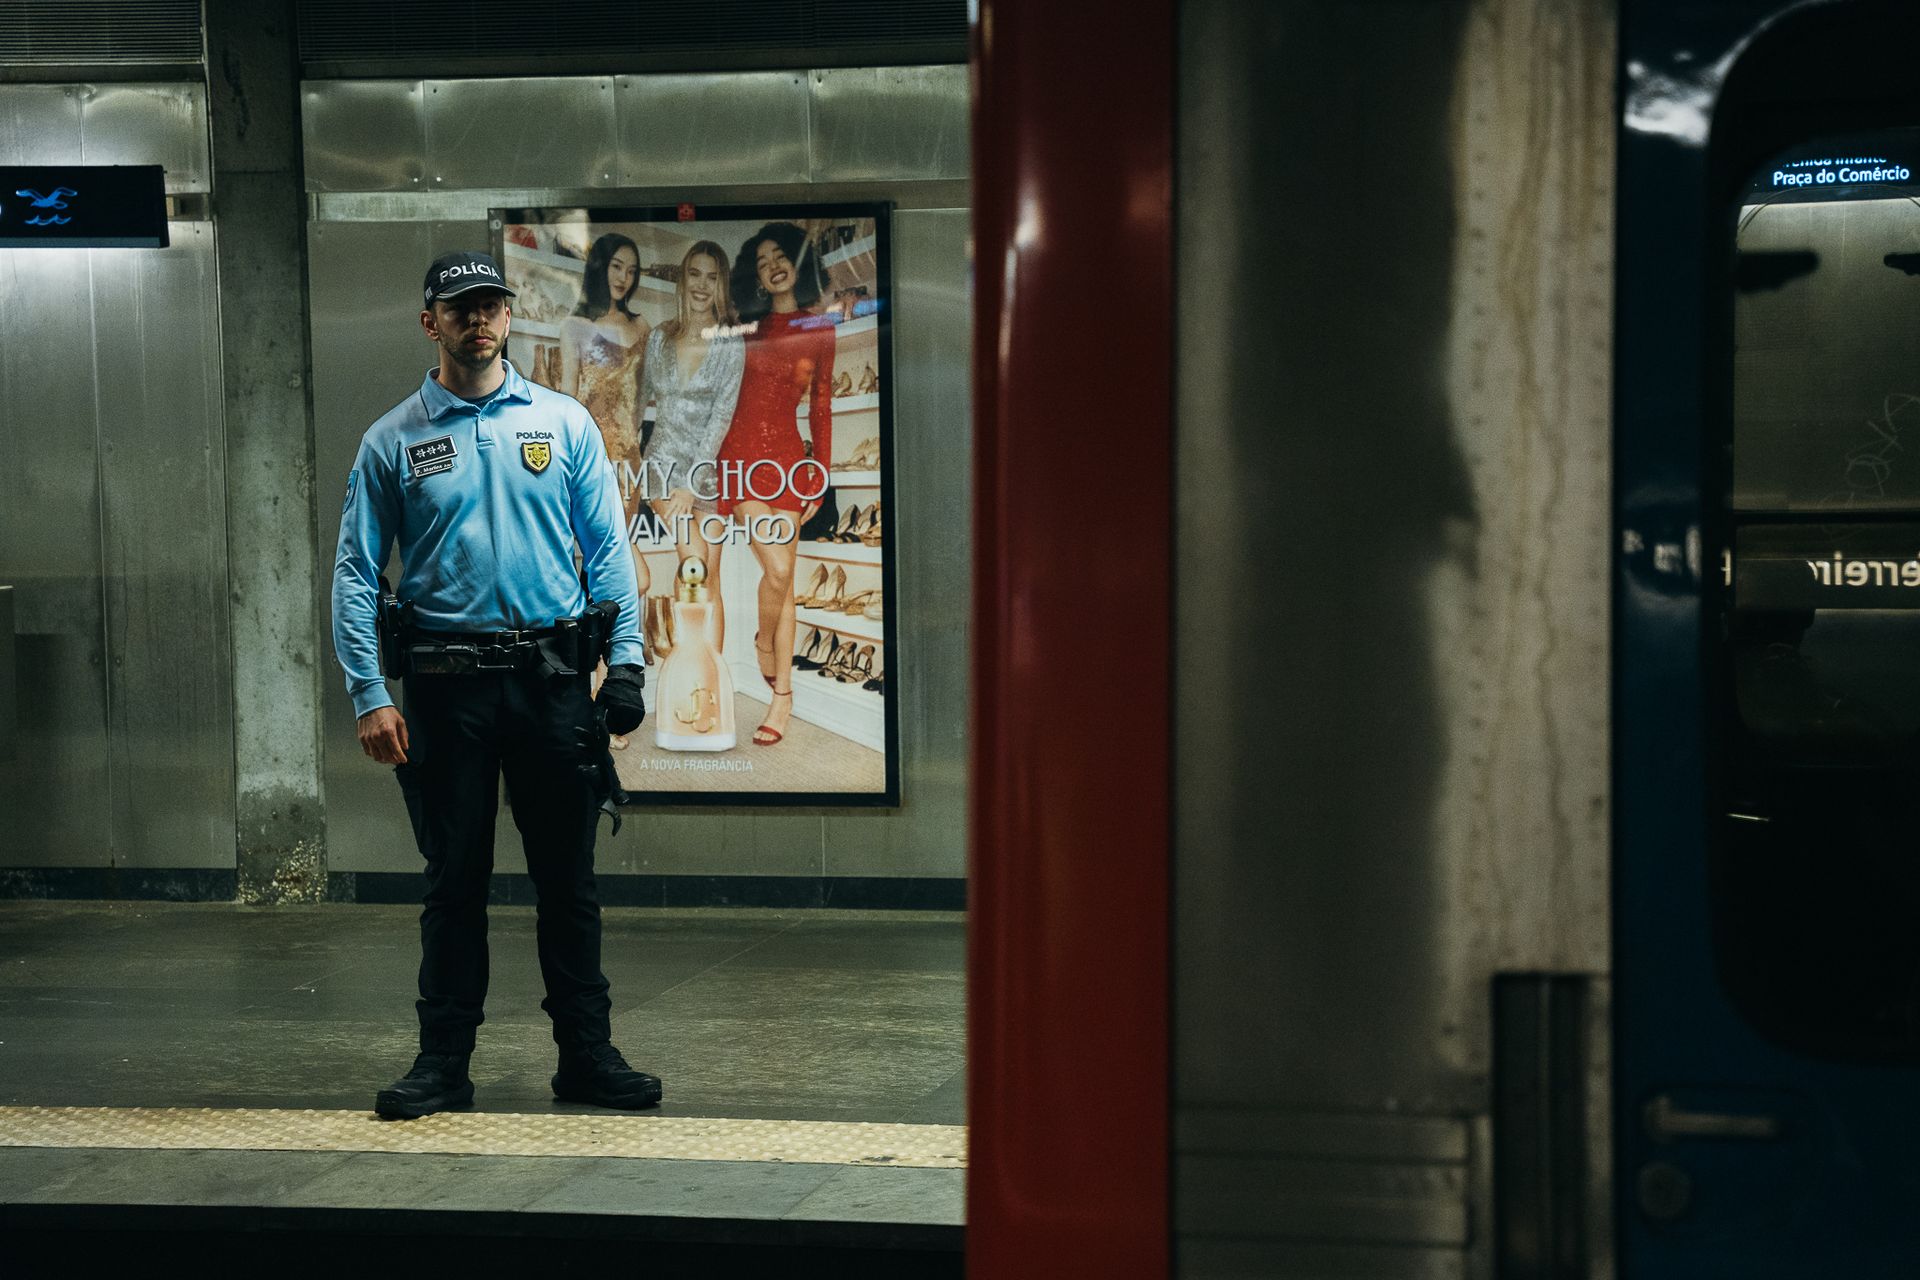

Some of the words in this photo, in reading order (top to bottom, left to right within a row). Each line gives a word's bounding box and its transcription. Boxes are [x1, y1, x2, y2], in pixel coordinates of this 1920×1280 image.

[1773, 170, 1813, 187] Praça
[1816, 168, 1836, 184] do
[1838, 165, 1910, 183] Comércio
[439, 261, 501, 284] POLÍCIA
[515, 430, 555, 440] POLÍCIA
[686, 458, 830, 502] CHOO
[701, 513, 796, 546] CHOO
[640, 759, 649, 770] A
[651, 759, 682, 771] NOVA
[684, 757, 753, 772] FRAGRÂNCIA
